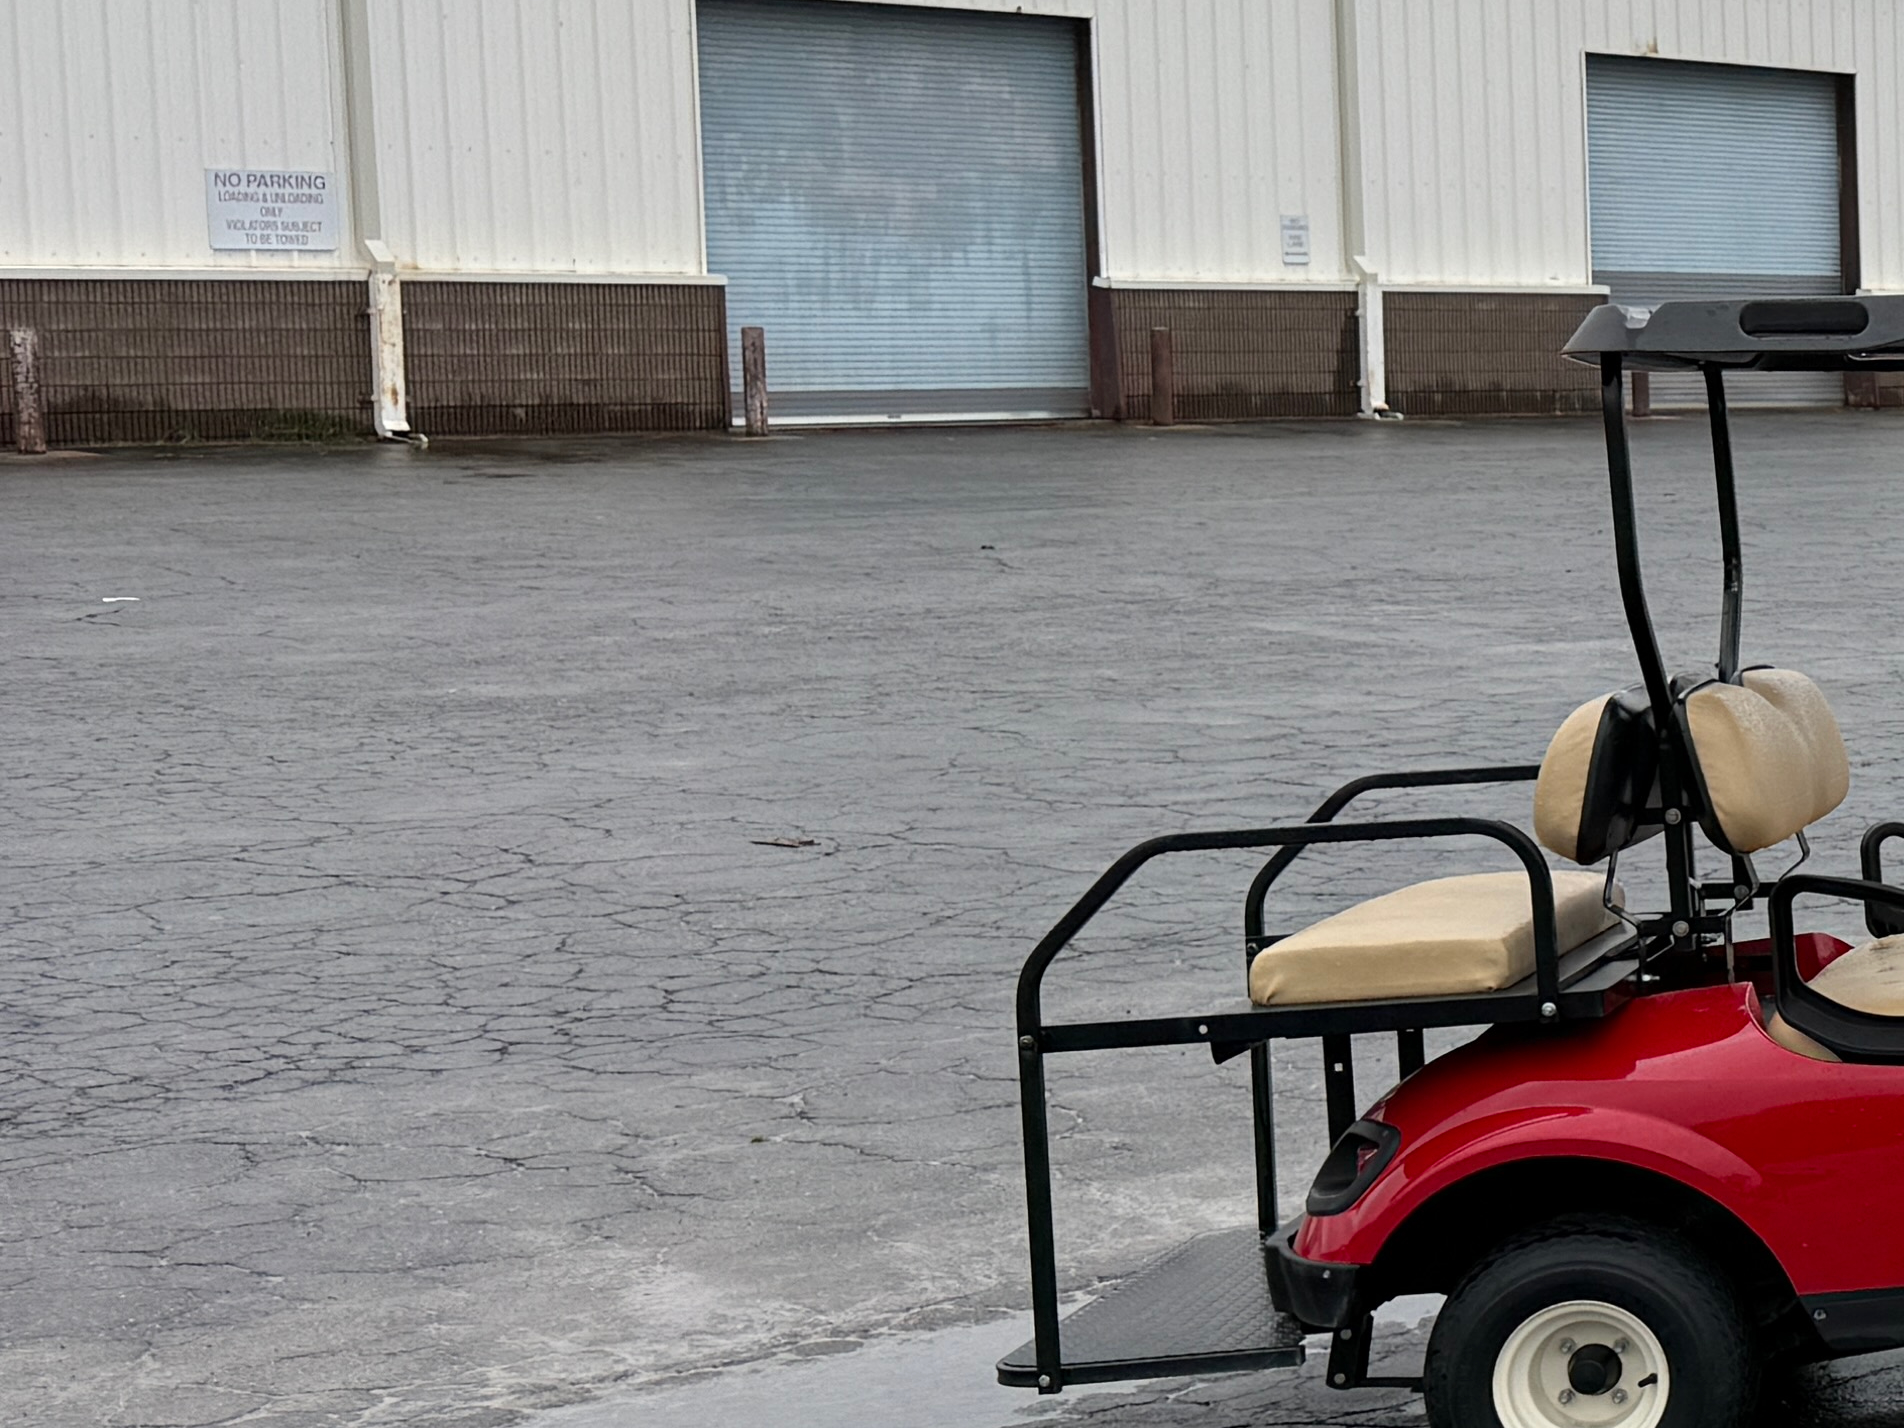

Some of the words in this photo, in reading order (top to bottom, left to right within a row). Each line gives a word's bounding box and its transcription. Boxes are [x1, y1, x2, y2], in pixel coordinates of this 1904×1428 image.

[214, 172, 241, 187] NO
[246, 173, 326, 189] PARKING
[218, 190, 260, 203] LOADING
[270, 192, 324, 204] UNLOADING
[260, 206, 283, 218] ONLY
[226, 219, 279, 232] VIOLATORS
[280, 221, 323, 232] SUBJECT
[245, 233, 257, 245] TO
[260, 233, 272, 245] BE
[275, 234, 309, 246] TOWED
